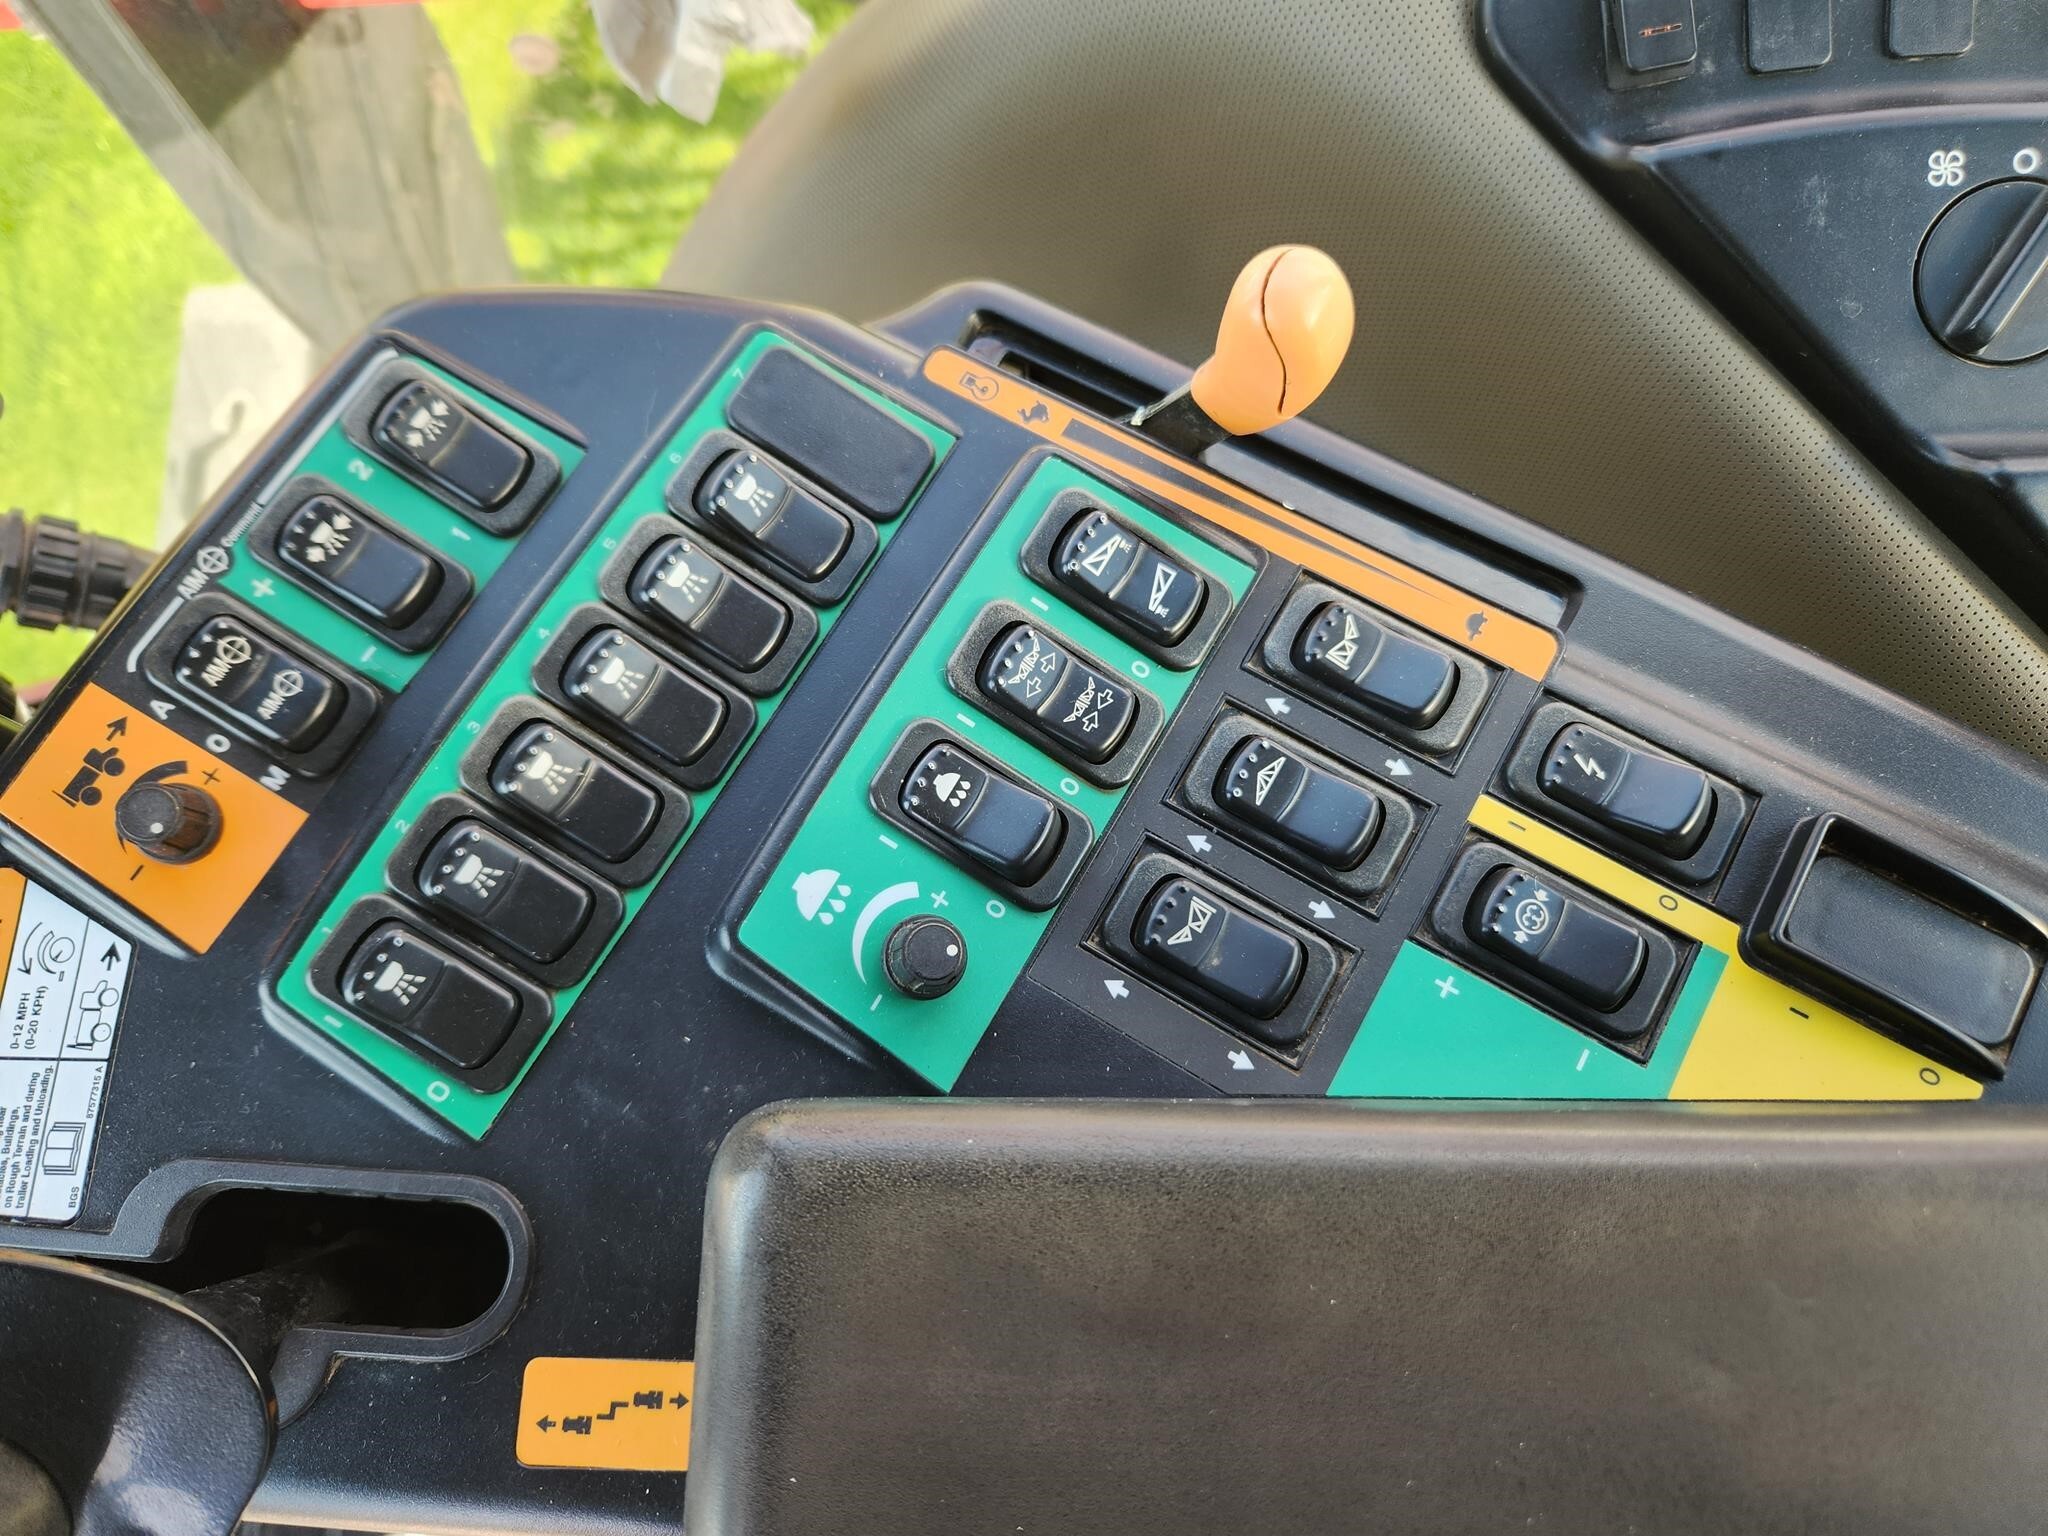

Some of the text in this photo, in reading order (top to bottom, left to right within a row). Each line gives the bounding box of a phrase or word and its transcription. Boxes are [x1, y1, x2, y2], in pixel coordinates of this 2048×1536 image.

[348, 459, 374, 481] 2
[177, 567, 210, 600] AIM
[201, 657, 232, 687] AIM
[150, 699, 176, 720] A
[257, 691, 286, 720] AIM
[259, 764, 291, 791] M
[10, 992, 30, 1049] 0-12 MPH
[24, 985, 49, 1050] (0-20 KPH)
[86, 1075, 102, 1119] 87577315
[1, 1107, 20, 1154] Buildings,
[4, 1072, 40, 1208] on Rough Terrain and during
[15, 1065, 53, 1209] trailer Loading and Unloading.
[68, 1186, 80, 1208] BGS
